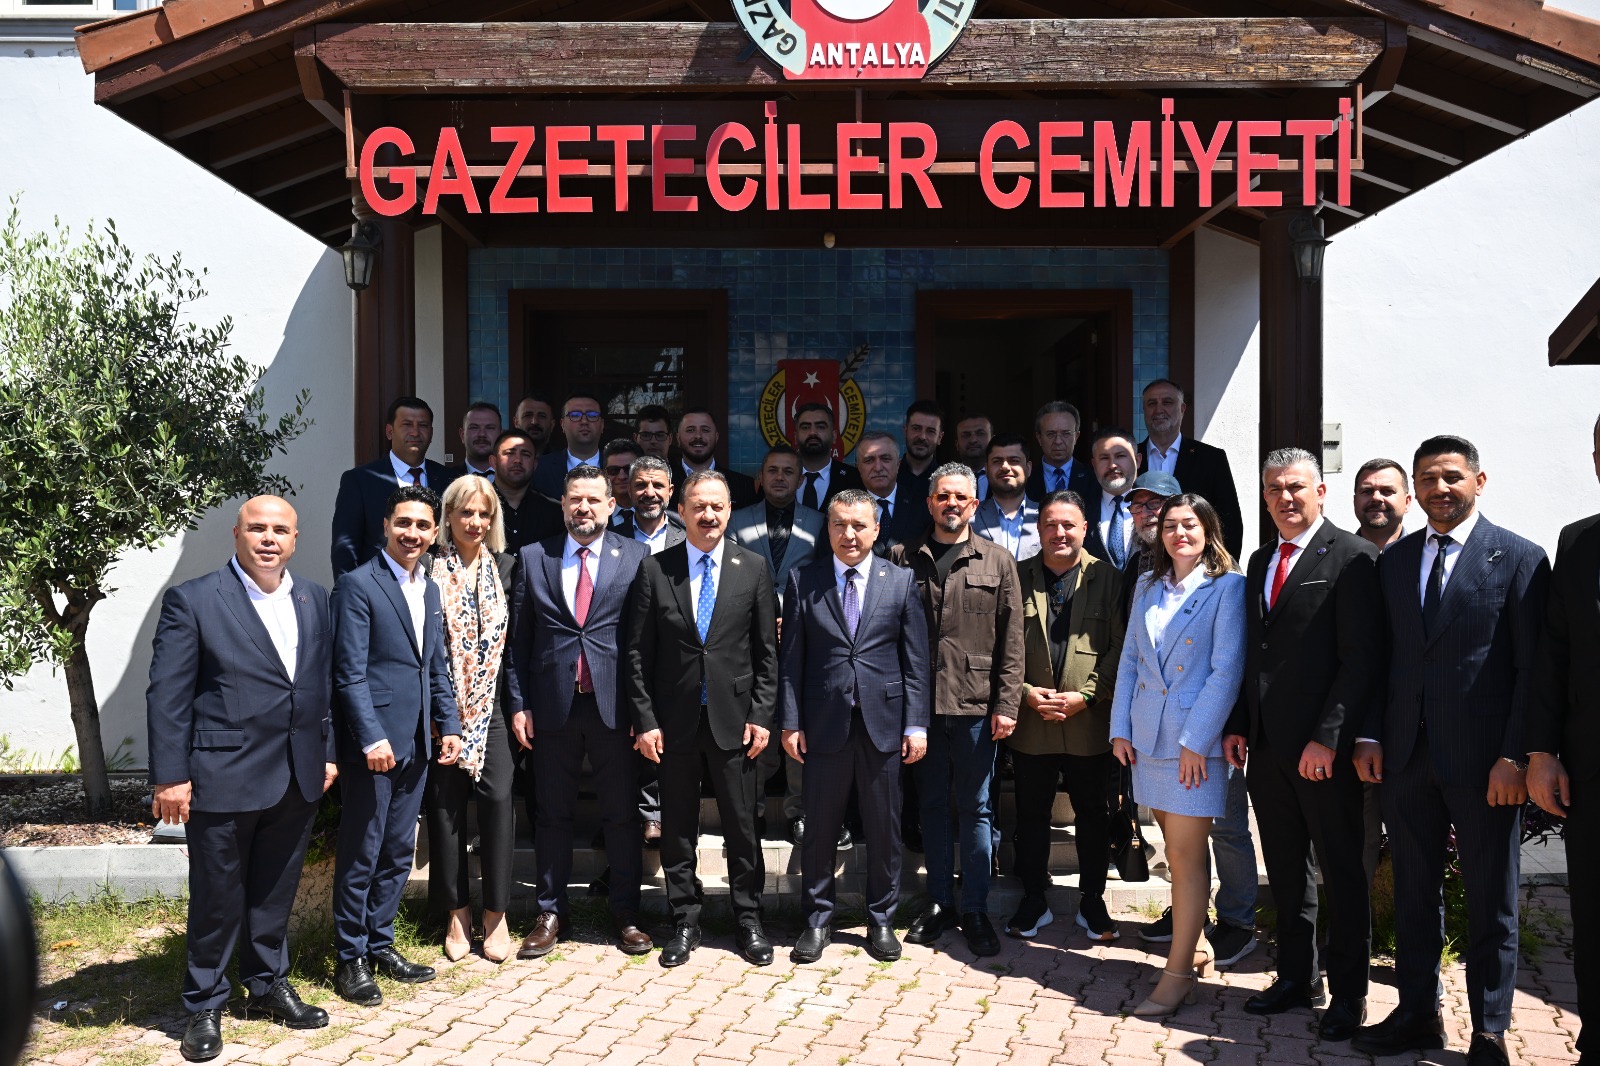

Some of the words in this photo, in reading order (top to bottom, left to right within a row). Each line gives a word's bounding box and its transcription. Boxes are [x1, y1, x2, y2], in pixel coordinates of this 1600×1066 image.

[809, 42, 926, 66] ANTALYA
[359, 100, 943, 216] GAZETECİLER
[979, 97, 1351, 209] CEMİYETİ
[762, 380, 785, 444] AZETECİLER
[843, 385, 863, 445] CEMİYETİ
